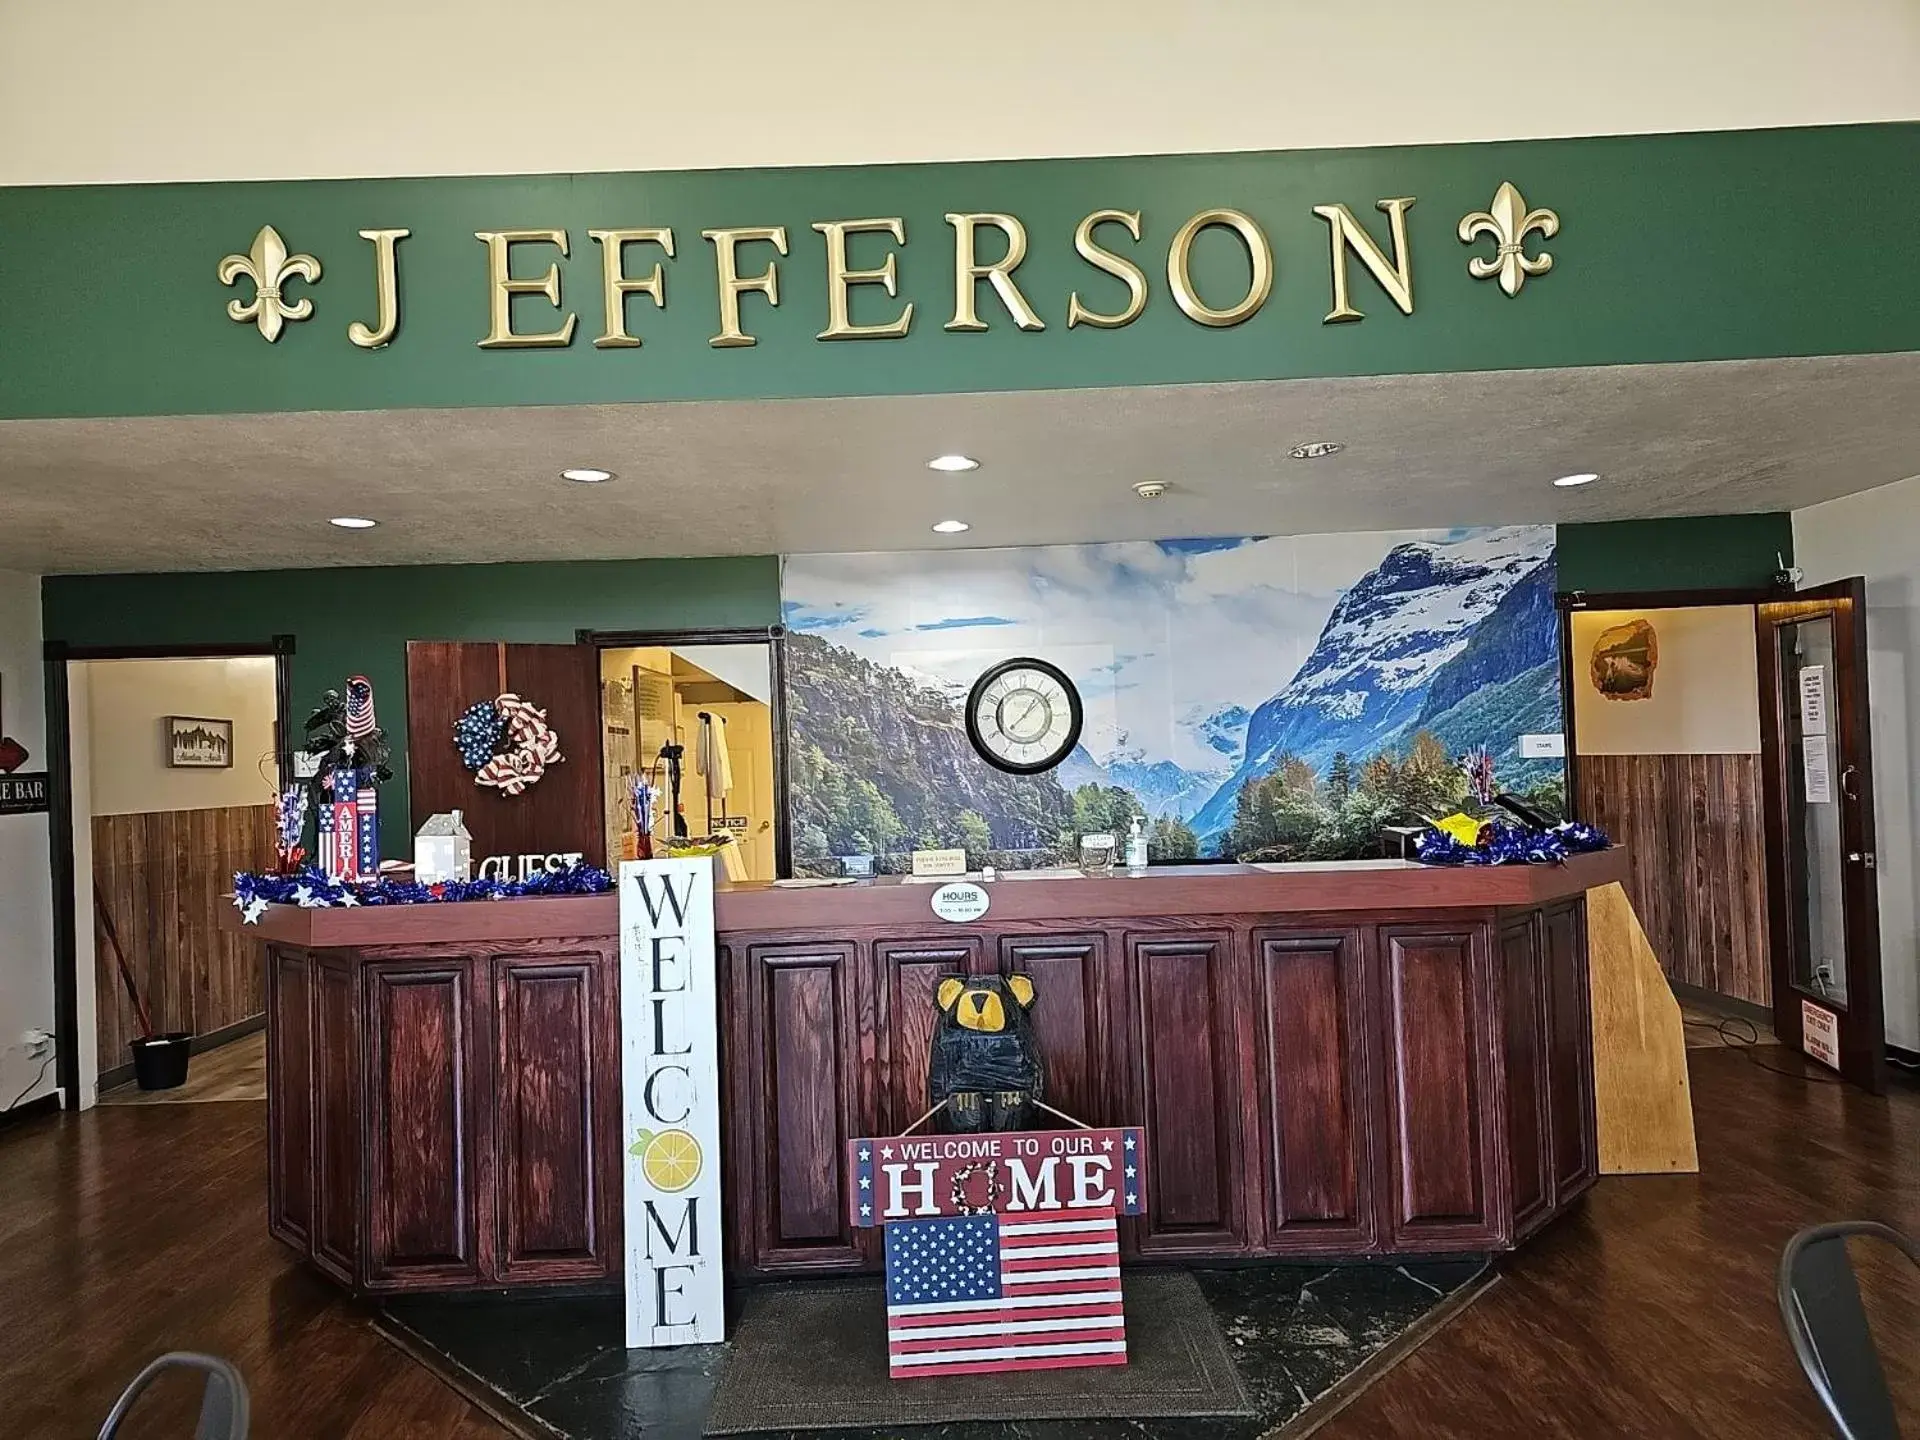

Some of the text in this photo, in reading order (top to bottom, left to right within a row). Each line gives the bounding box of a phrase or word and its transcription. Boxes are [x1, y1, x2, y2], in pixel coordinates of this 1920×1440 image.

[348, 196, 1416, 349] JEFFERSON
[15, 781, 43, 800] BAR
[942, 891, 978, 901] HOURS
[900, 1137, 1094, 1160] WELCOME TO OUR
[881, 1154, 1116, 1217] HOME
